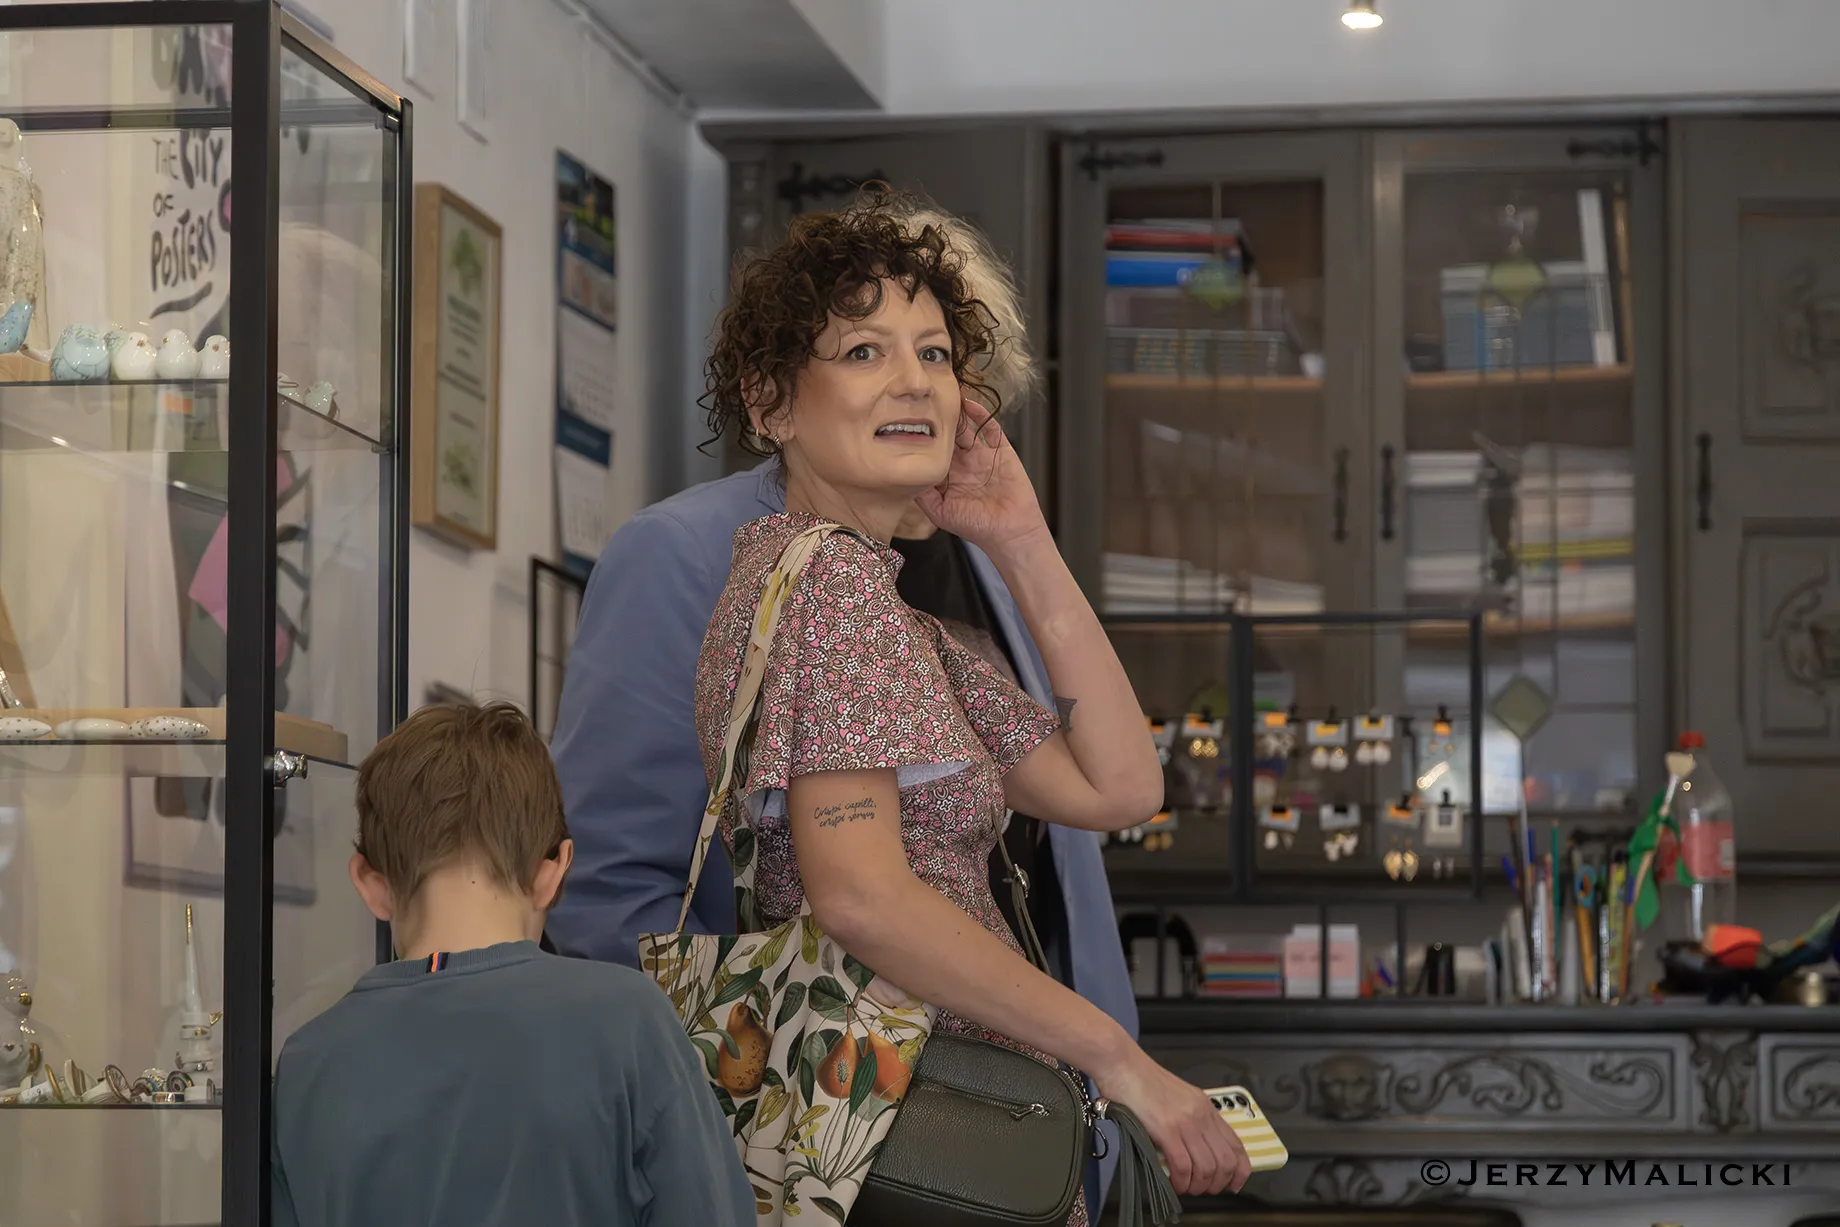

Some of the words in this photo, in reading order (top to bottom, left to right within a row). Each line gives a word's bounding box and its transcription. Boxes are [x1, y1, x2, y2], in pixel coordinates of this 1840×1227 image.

[152, 137, 178, 180] THE
[180, 128, 223, 189] CITY
[153, 192, 174, 217] OF
[151, 209, 216, 291] POSTERS
